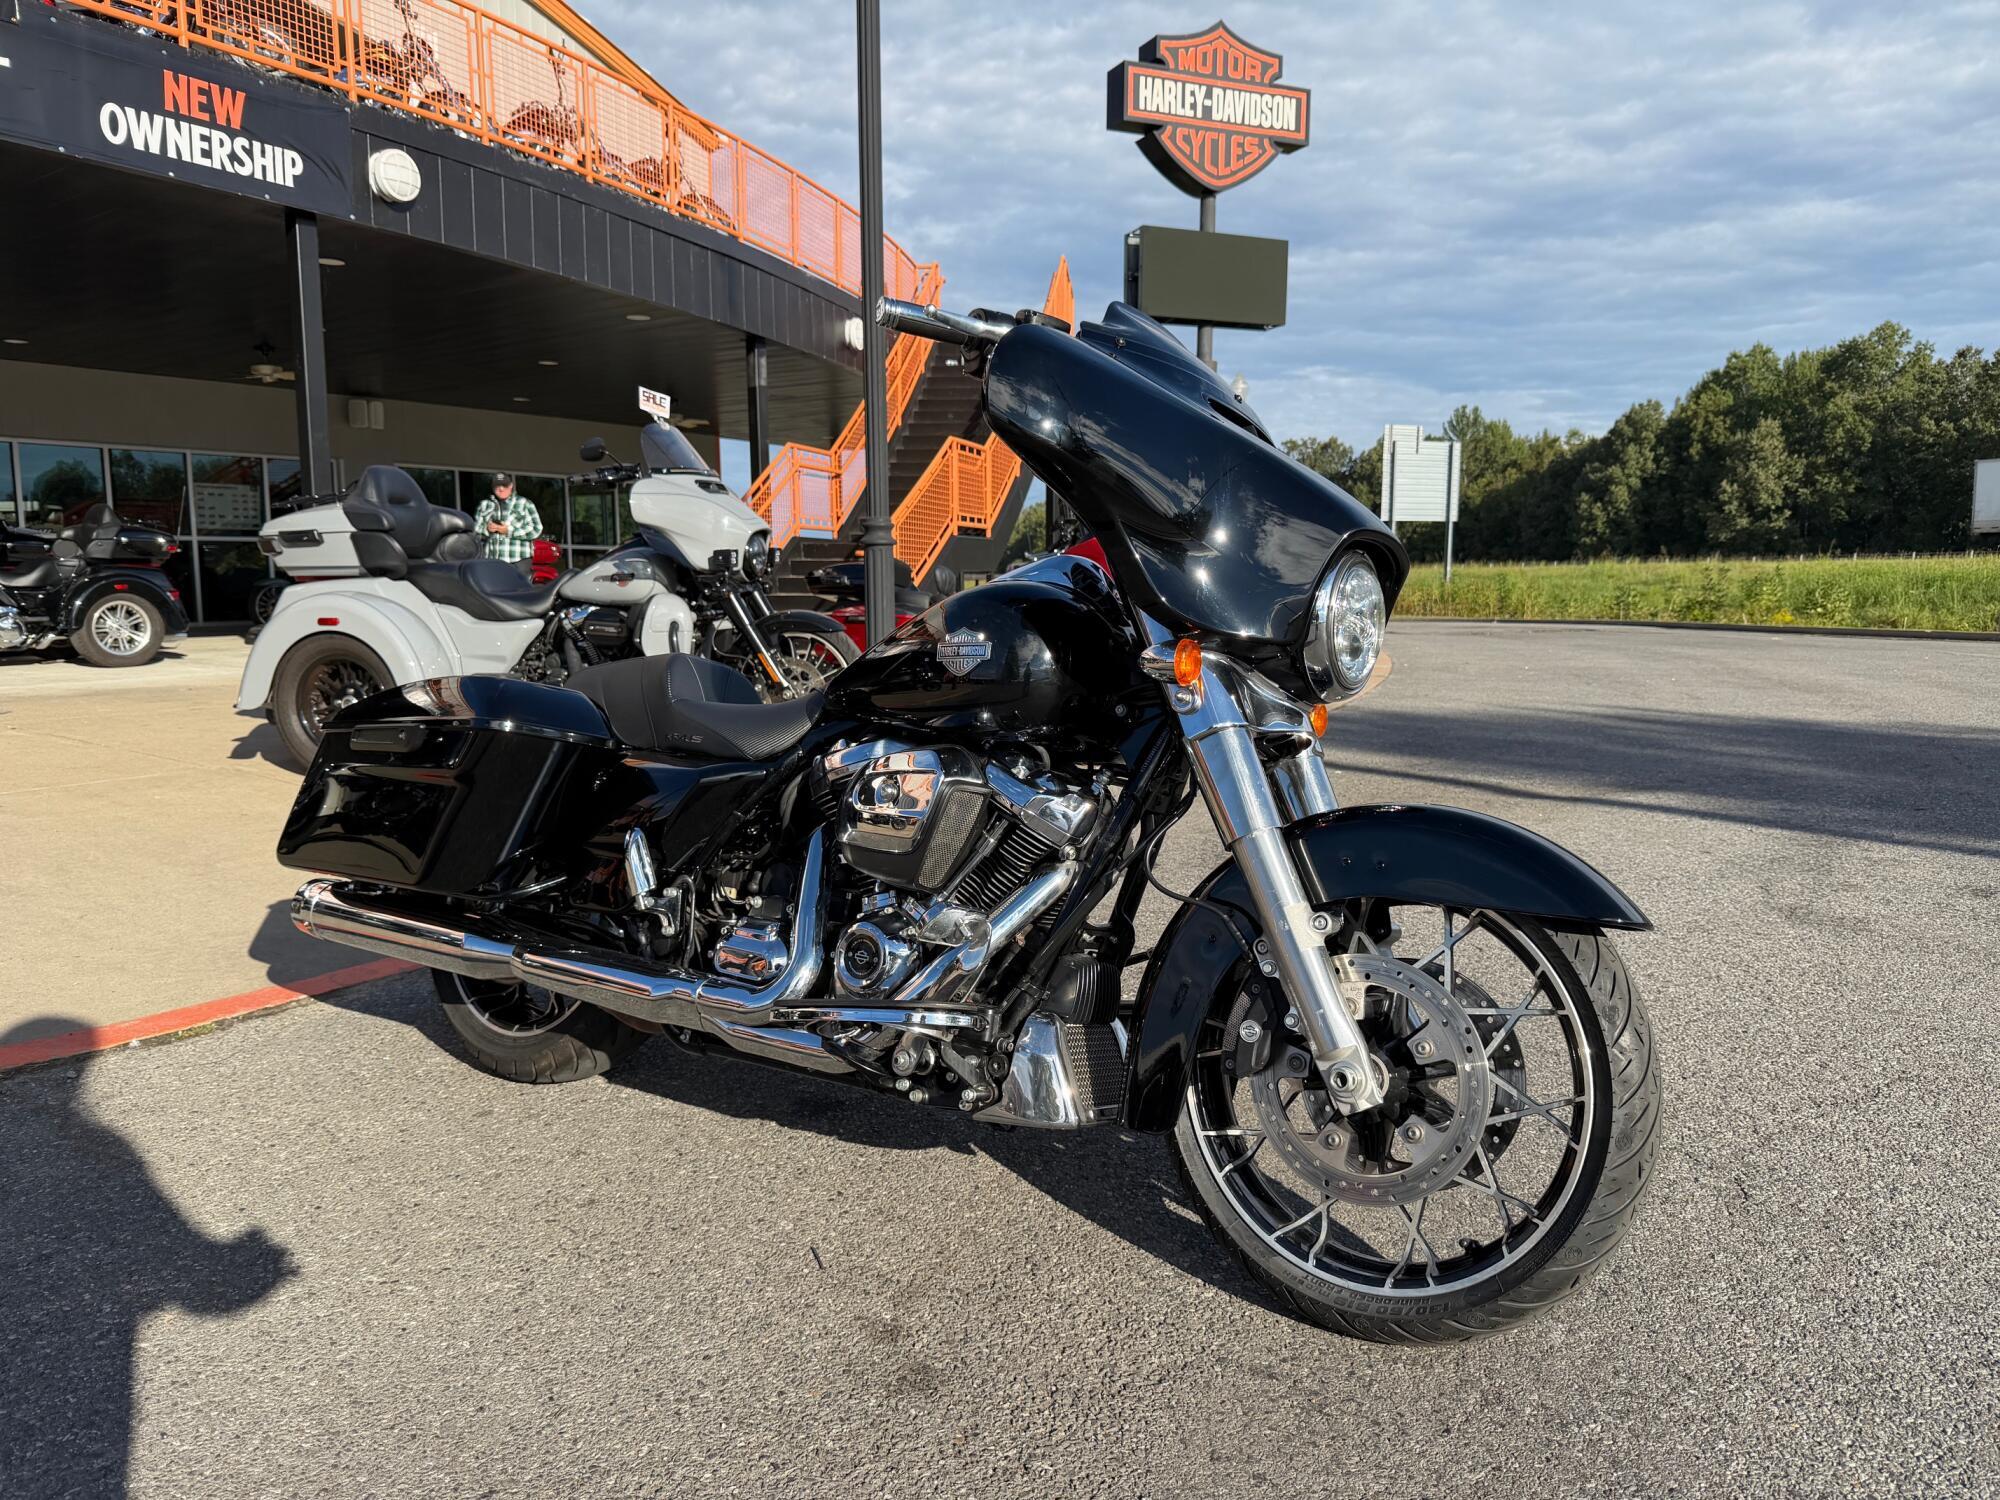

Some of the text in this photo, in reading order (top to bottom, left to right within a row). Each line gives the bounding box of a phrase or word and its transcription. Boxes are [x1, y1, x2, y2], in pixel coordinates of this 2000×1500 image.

[1178, 39, 1261, 83] MOTOR
[163, 69, 246, 130] NEW
[1138, 75, 1297, 131] HARLEY-DAVIDSON
[100, 102, 304, 188] OWNERSHIP
[1176, 127, 1260, 176] CYCLES
